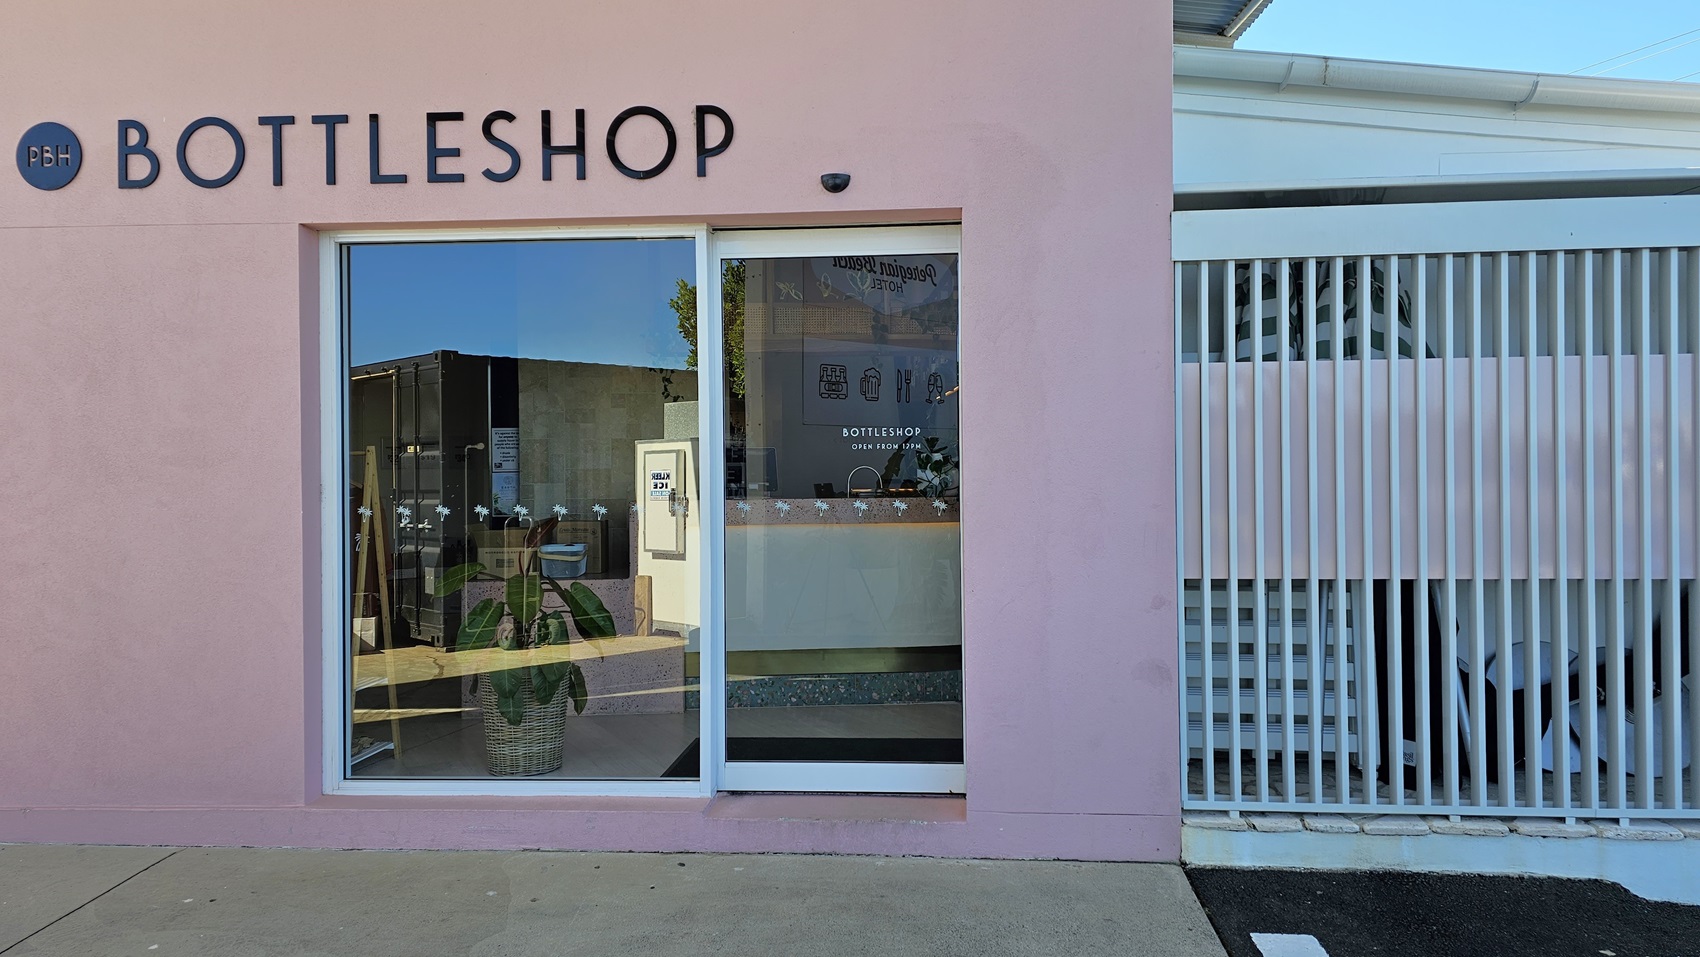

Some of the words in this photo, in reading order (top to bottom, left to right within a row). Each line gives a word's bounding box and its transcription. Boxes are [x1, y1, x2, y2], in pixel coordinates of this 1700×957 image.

[27, 144, 71, 168] PBH
[117, 104, 735, 189] BOTTLESHOP
[842, 427, 921, 437] BOTTLESHOP
